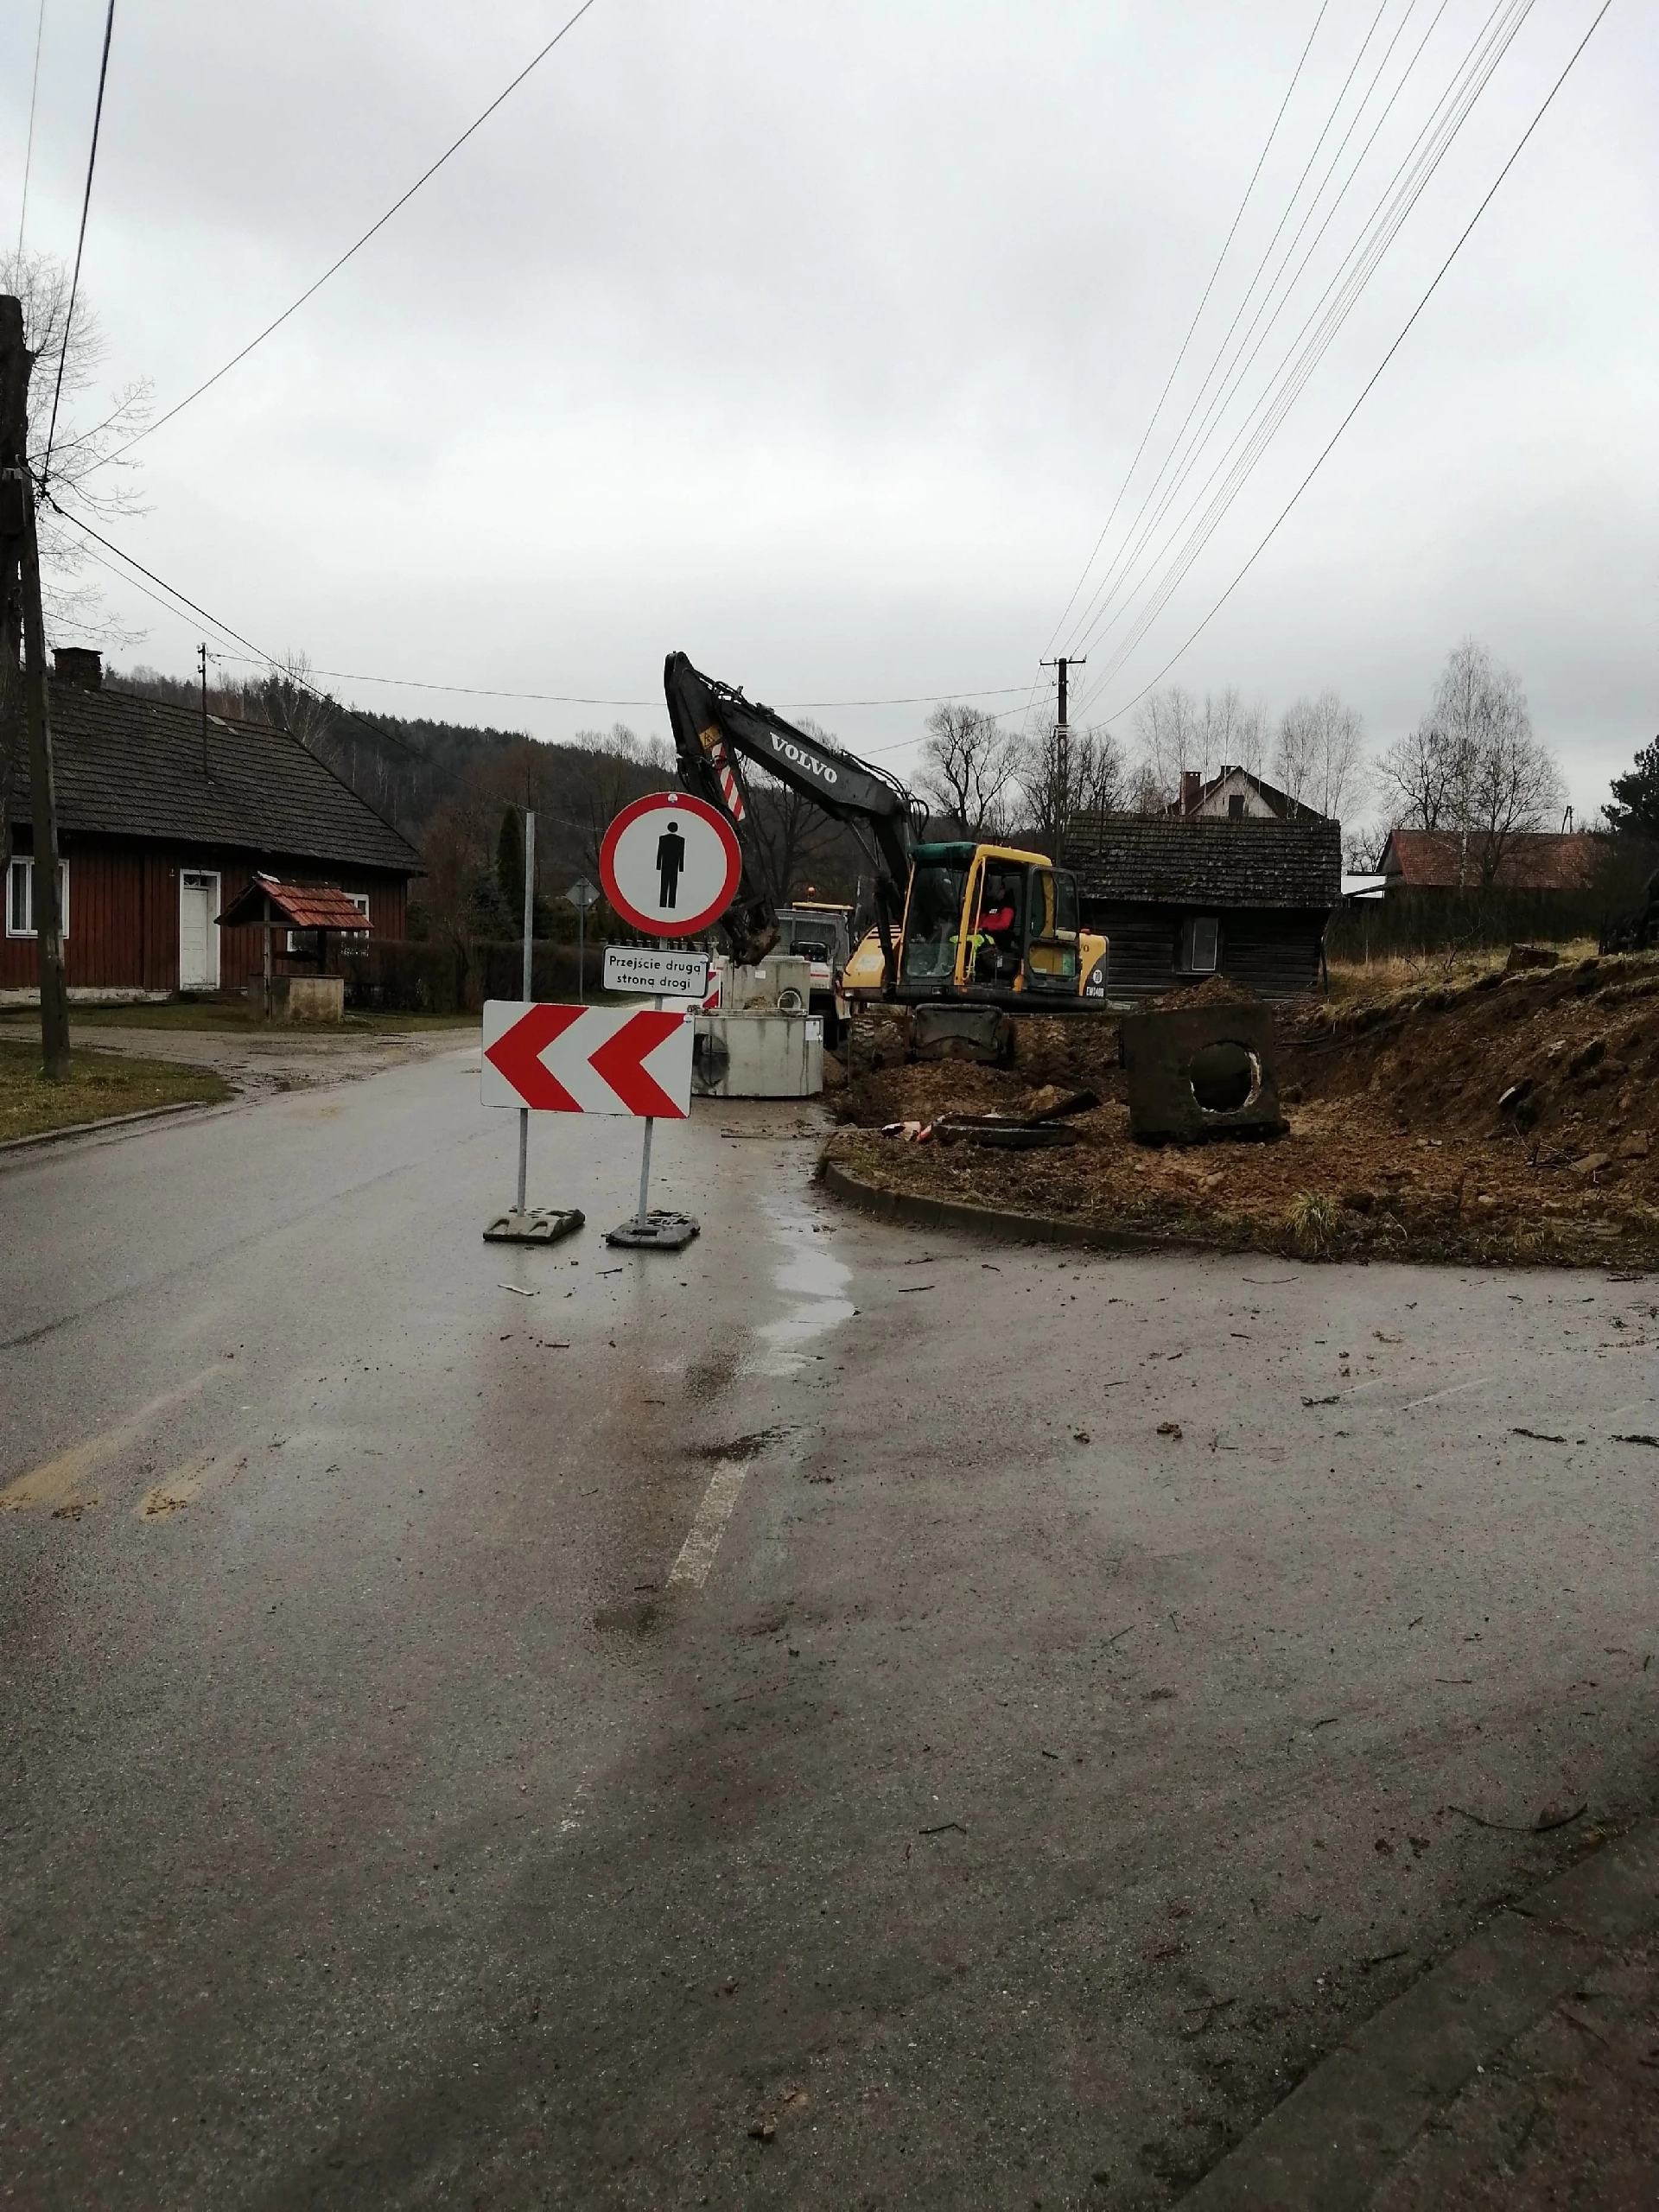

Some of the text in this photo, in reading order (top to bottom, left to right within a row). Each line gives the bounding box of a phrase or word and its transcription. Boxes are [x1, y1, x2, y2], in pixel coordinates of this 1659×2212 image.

[770, 732, 837, 784] VOLVO
[609, 956, 701, 976] Przejście drugą
[617, 974, 690, 991] stroną drogi
